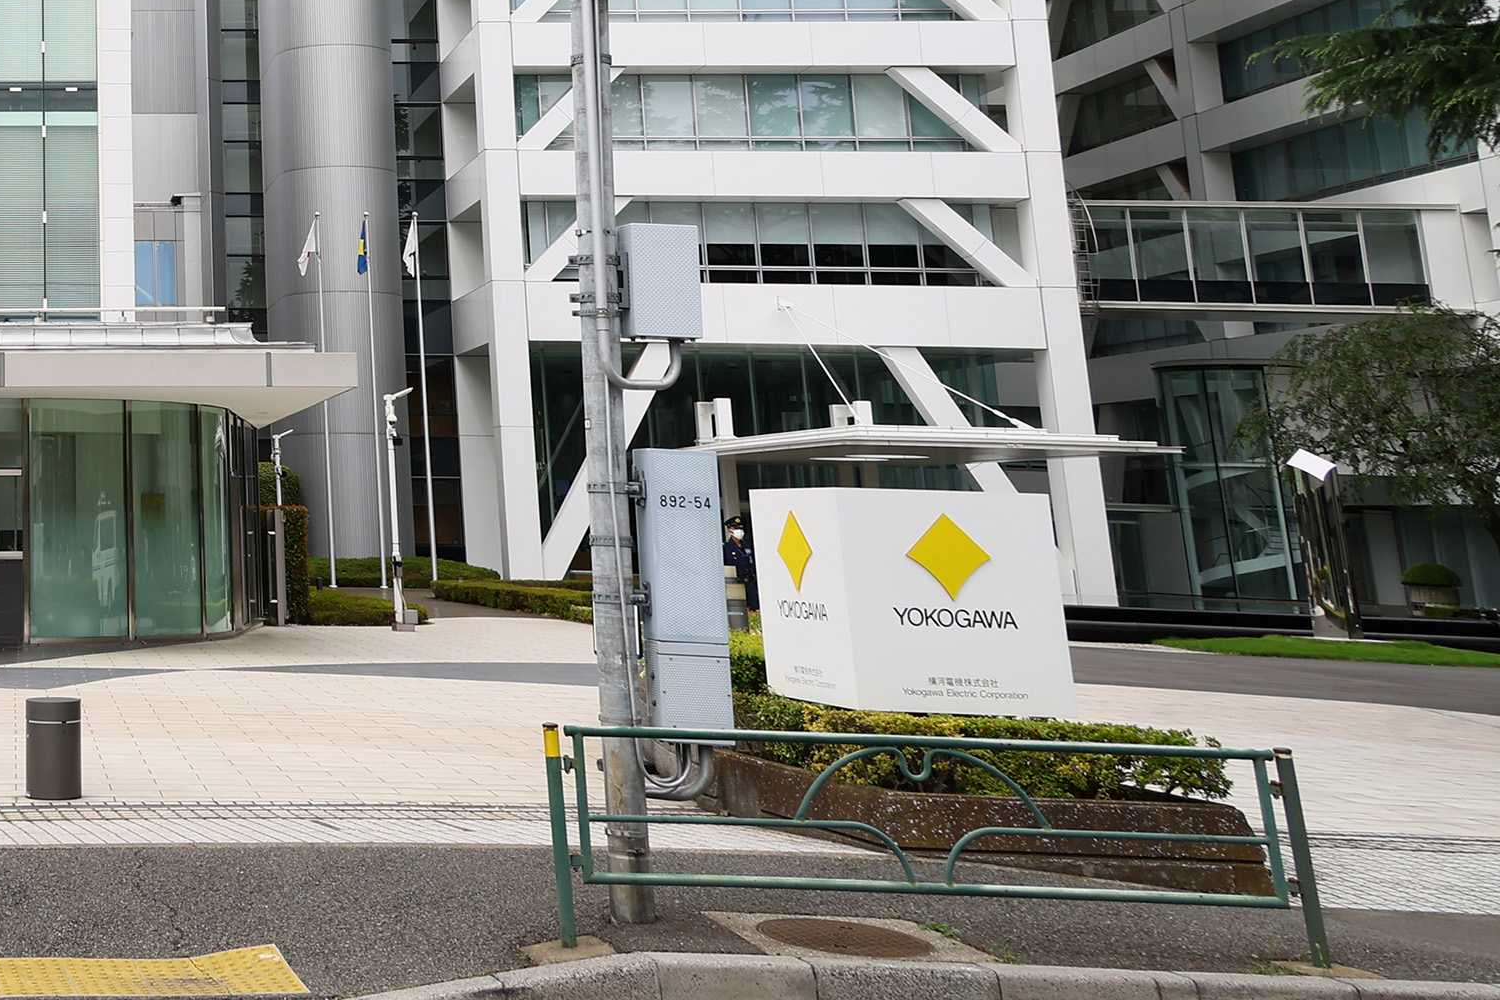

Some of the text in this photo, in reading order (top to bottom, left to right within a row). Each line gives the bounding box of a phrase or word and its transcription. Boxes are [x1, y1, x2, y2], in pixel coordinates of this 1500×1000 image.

[660, 494, 711, 509] 892-54
[777, 599, 829, 621] YOKOGAWA
[892, 606, 1019, 630] YOKOGAWA
[902, 687, 1029, 700] Yokogawa Electric Corporation
